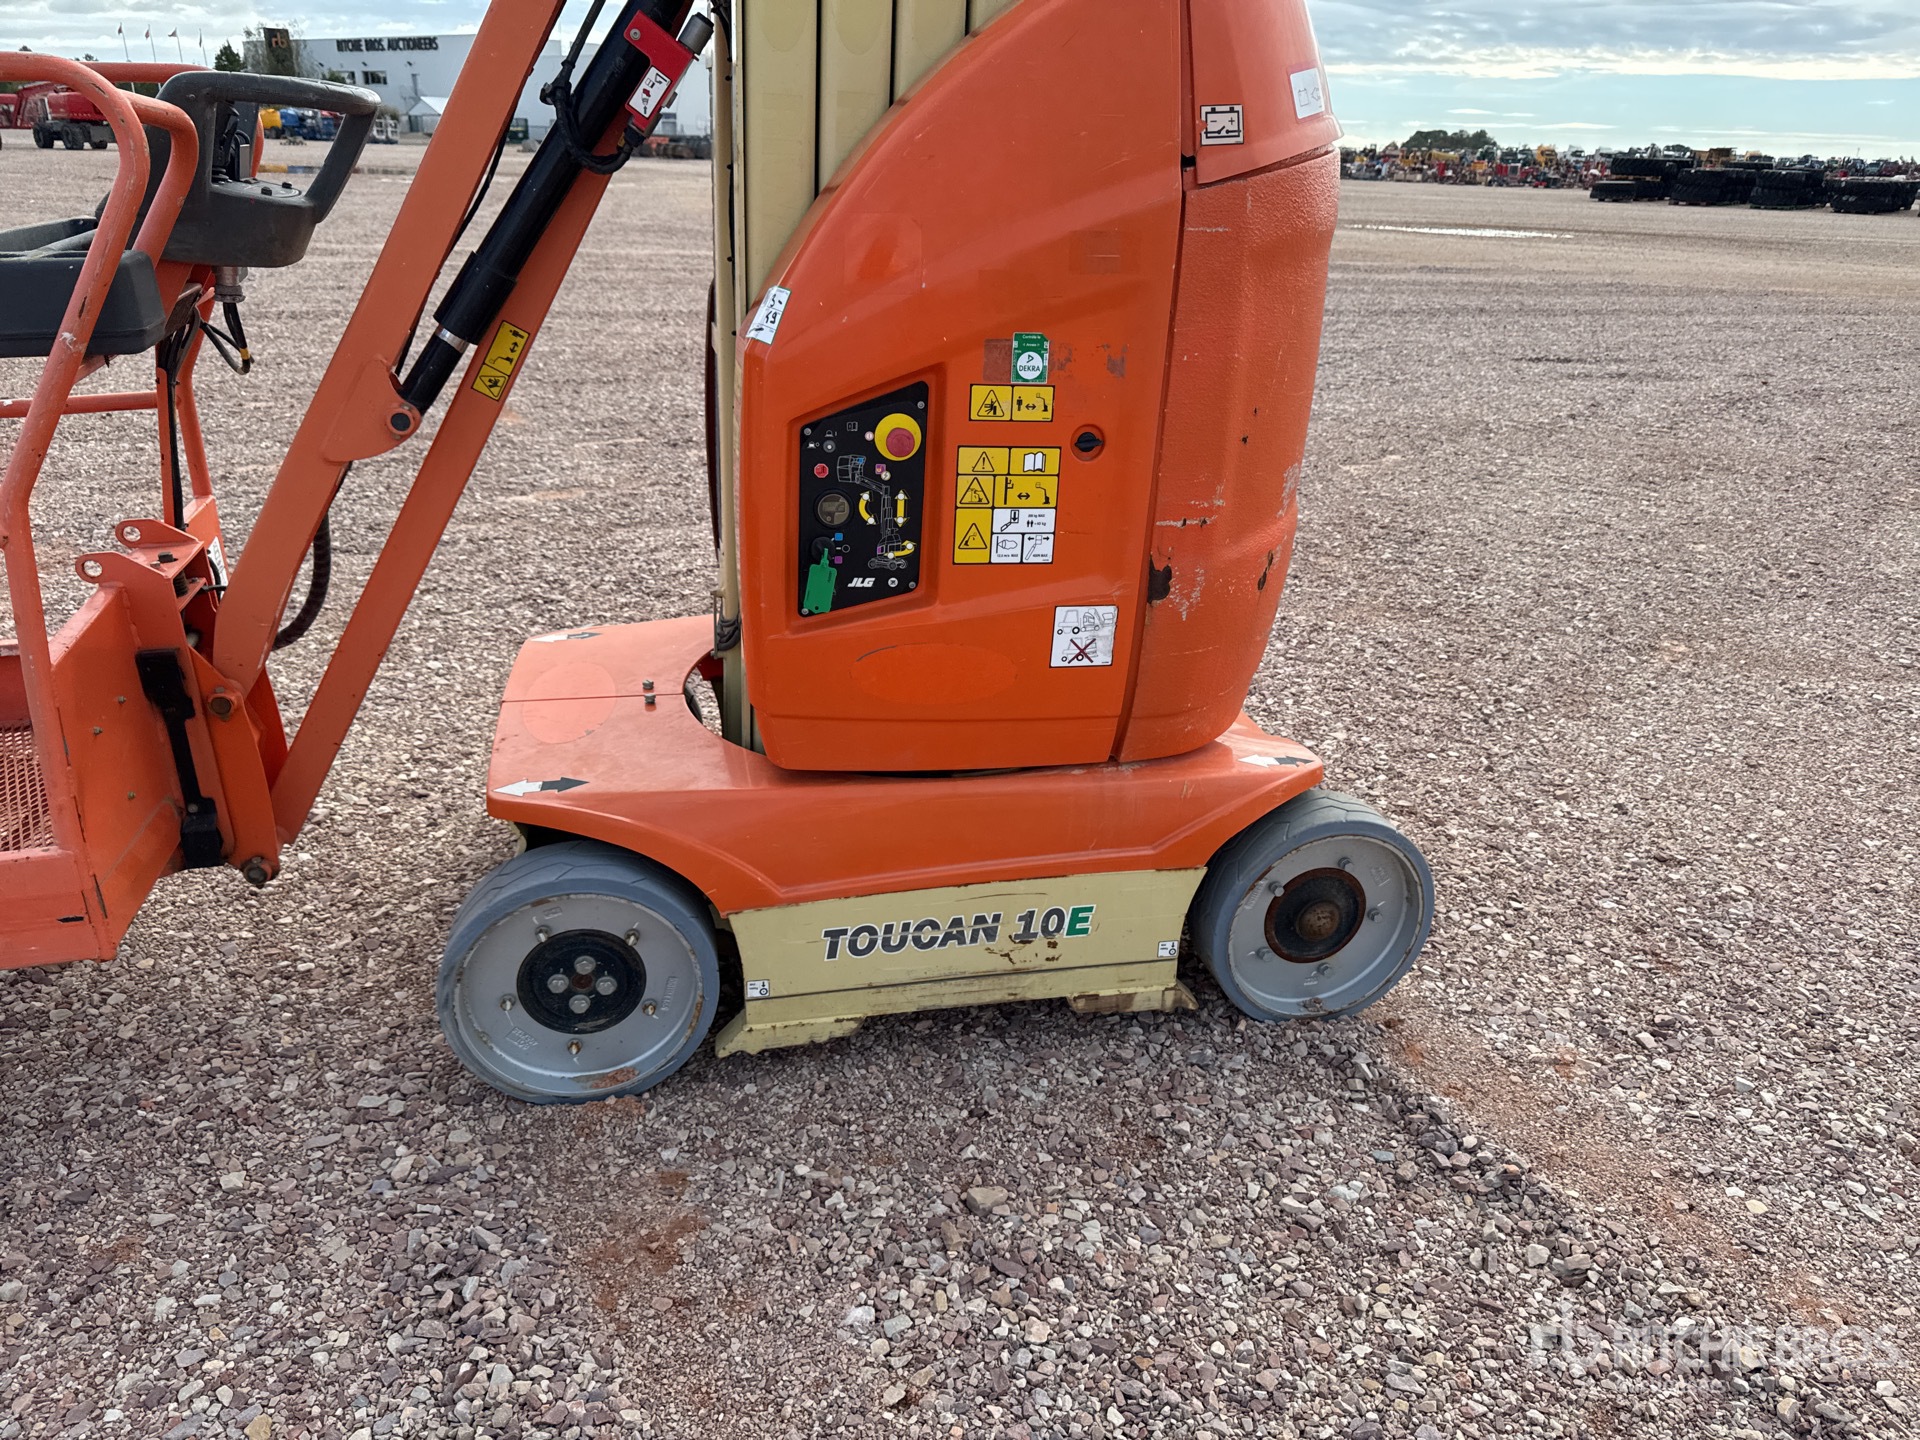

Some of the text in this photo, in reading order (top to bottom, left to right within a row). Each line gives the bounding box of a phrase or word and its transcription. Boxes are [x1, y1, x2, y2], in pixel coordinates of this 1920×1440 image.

[336, 39, 363, 52] RITCHIE
[387, 36, 439, 51] AUCTIONEERS
[847, 577, 876, 588] JLG
[821, 903, 1097, 962] TOUCAN 10E
